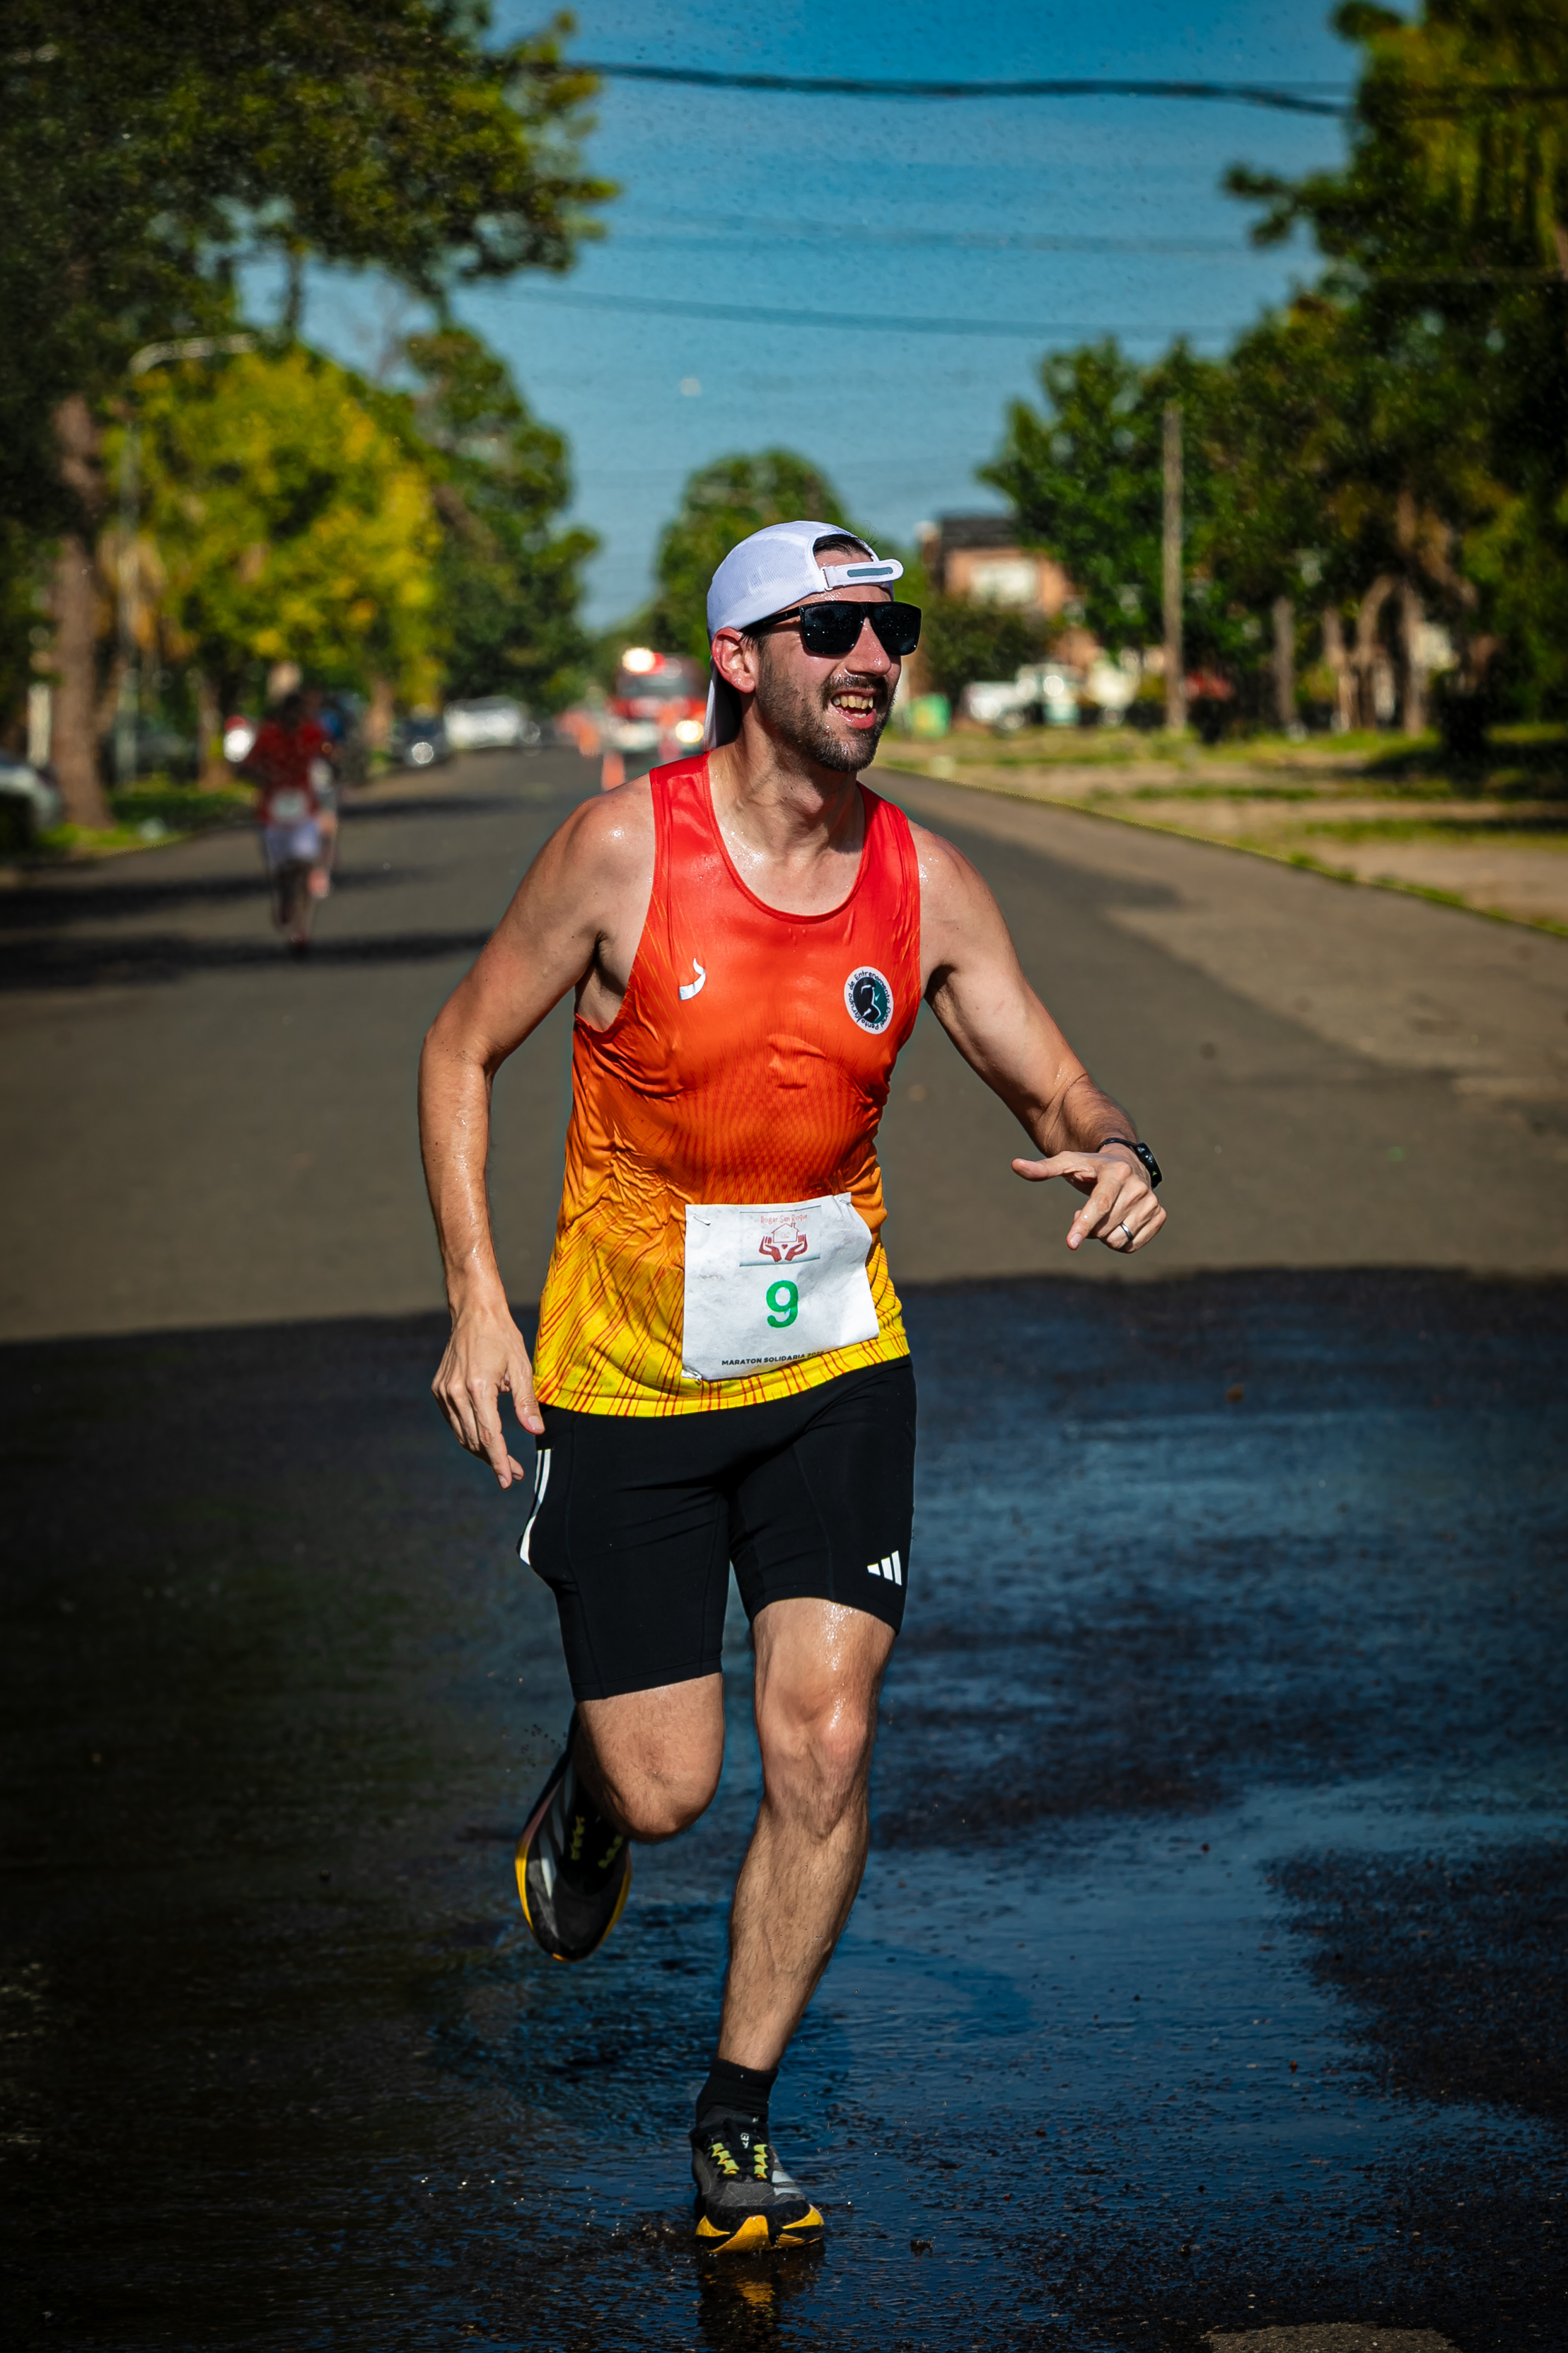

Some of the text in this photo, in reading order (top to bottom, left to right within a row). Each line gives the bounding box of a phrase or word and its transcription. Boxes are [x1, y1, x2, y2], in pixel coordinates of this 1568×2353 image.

[847, 981, 855, 990] de
[849, 993, 860, 1018] Grupo
[791, 1214, 808, 1222] Roque
[766, 1280, 798, 1328] 9
[764, 1353, 805, 1363] SOLIDARIA
